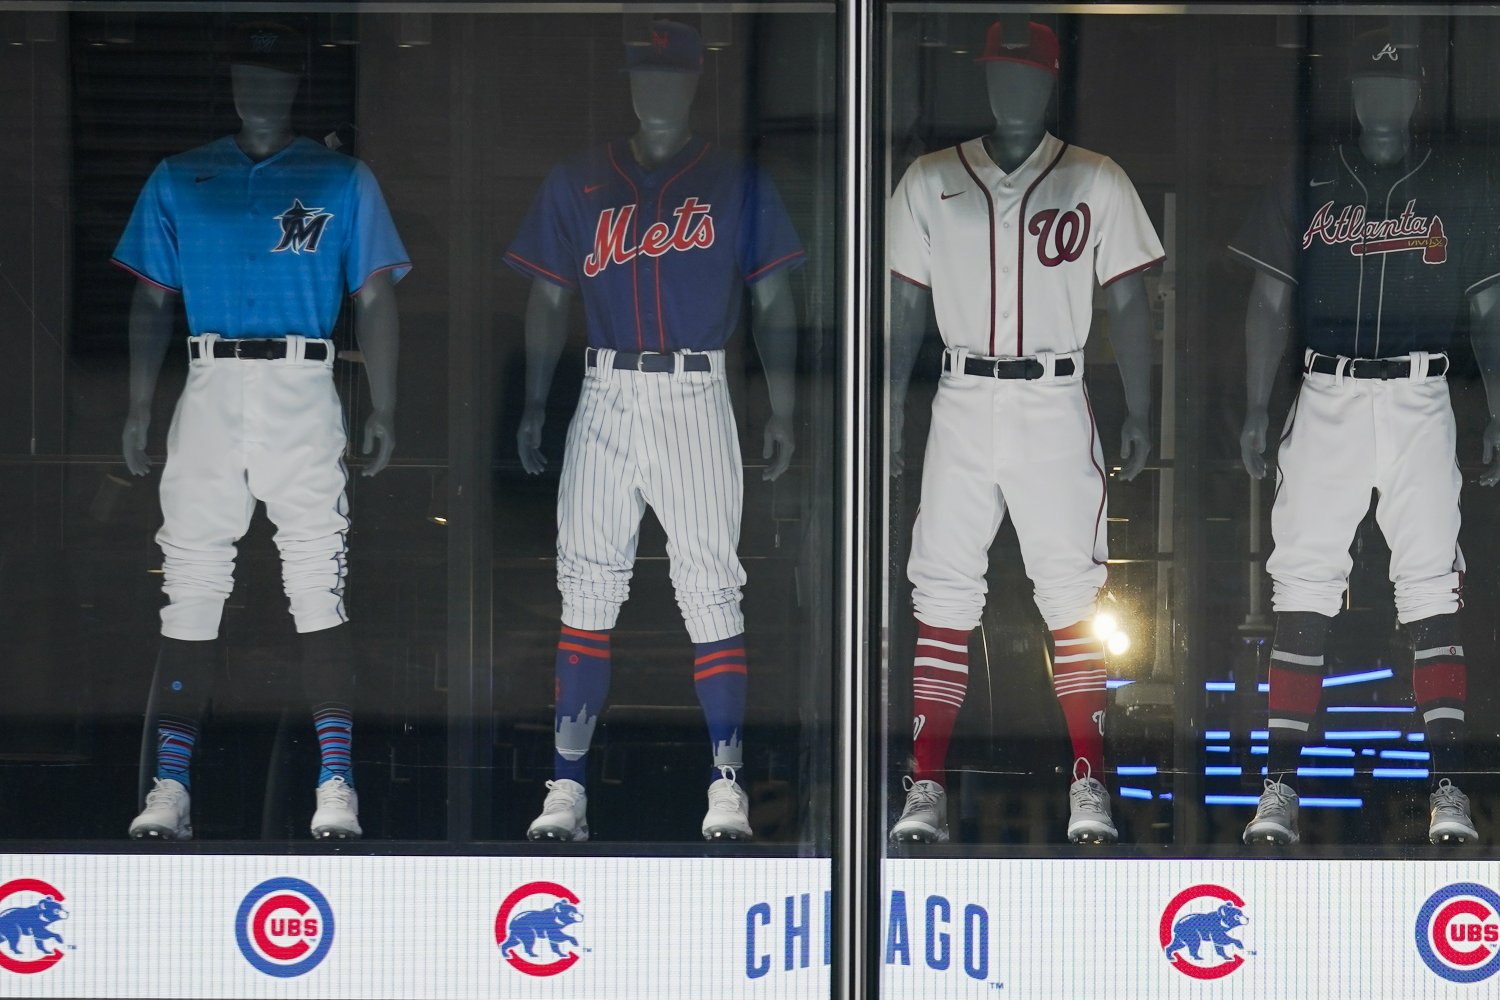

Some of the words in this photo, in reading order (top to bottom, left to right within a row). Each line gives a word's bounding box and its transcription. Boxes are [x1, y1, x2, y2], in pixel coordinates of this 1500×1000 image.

[584, 197, 714, 277] Mets
[1028, 202, 1091, 267] W
[1302, 199, 1428, 250] Atlanta
[746, 889, 989, 980] CHIAGO
